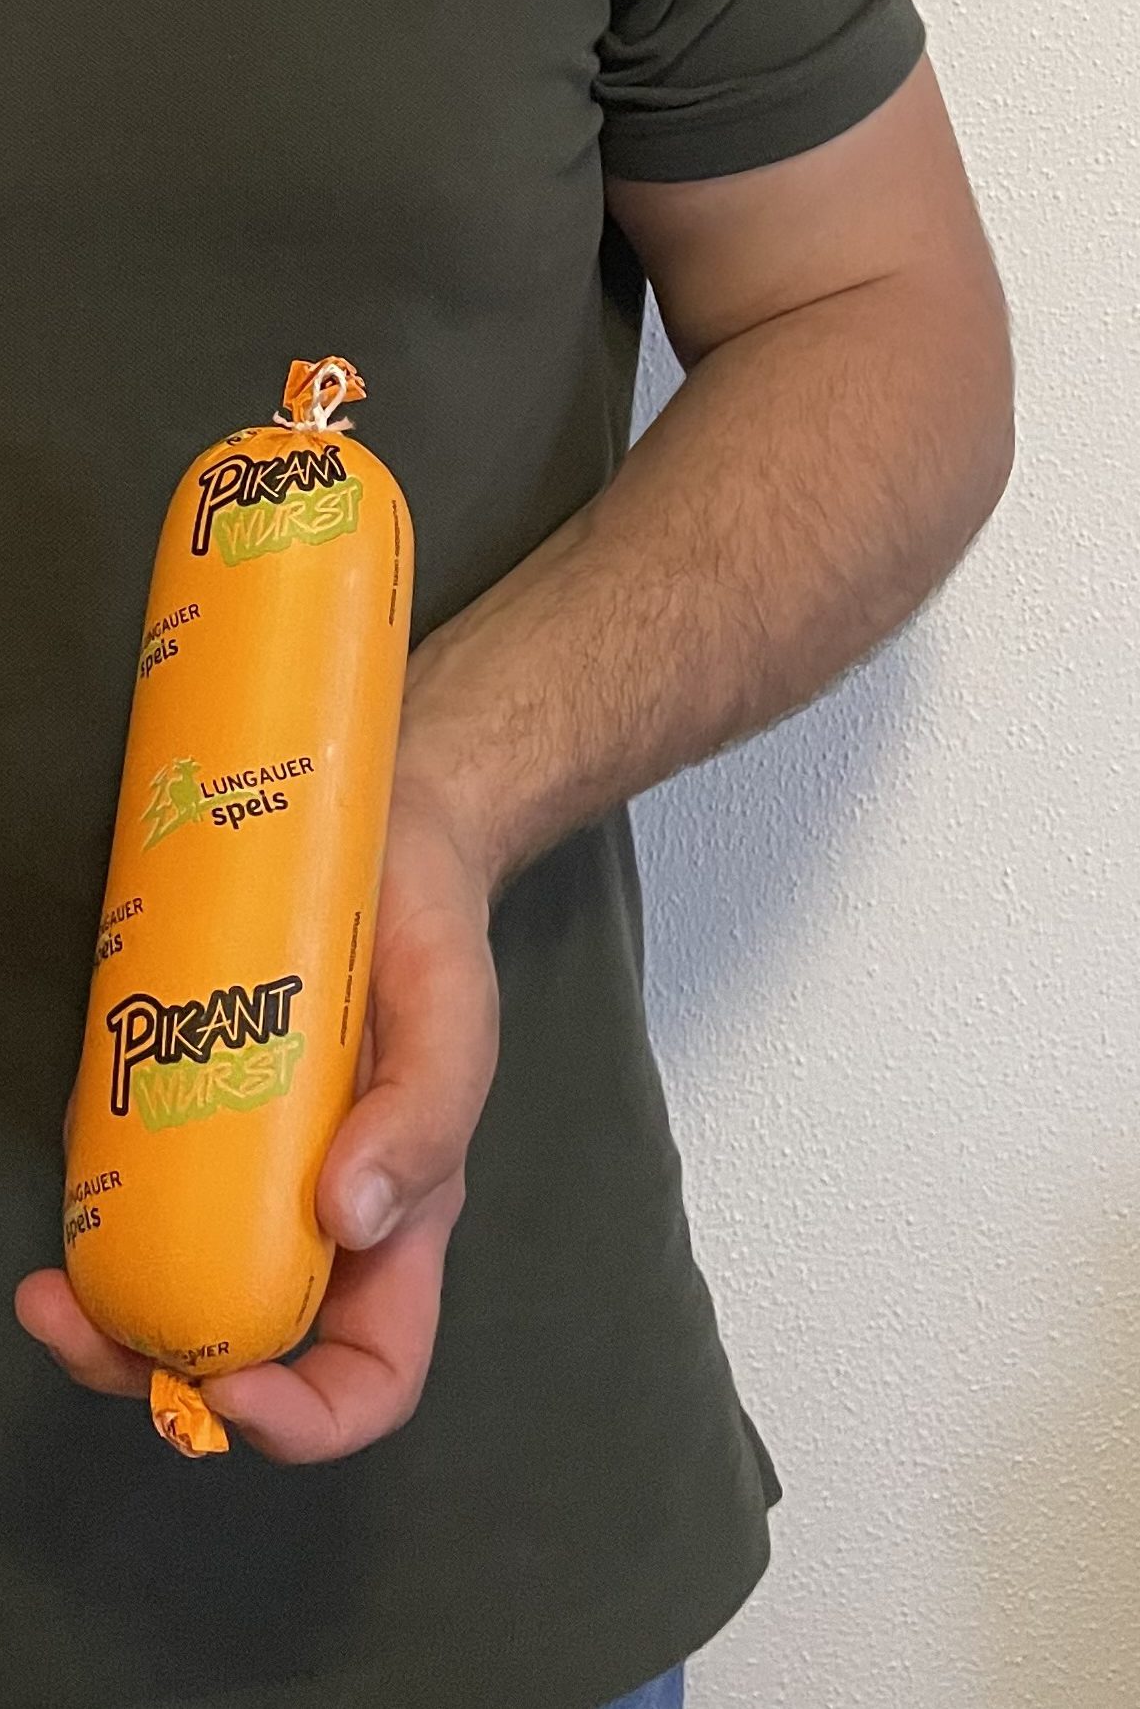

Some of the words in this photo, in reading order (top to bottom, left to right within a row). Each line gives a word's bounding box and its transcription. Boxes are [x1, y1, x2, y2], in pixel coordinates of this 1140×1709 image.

[213, 477, 363, 567] WURST
[201, 757, 315, 799] LUNGAUER
[211, 788, 289, 831] speis
[106, 975, 303, 1116] PIKANT
[130, 1032, 306, 1133] WURST
